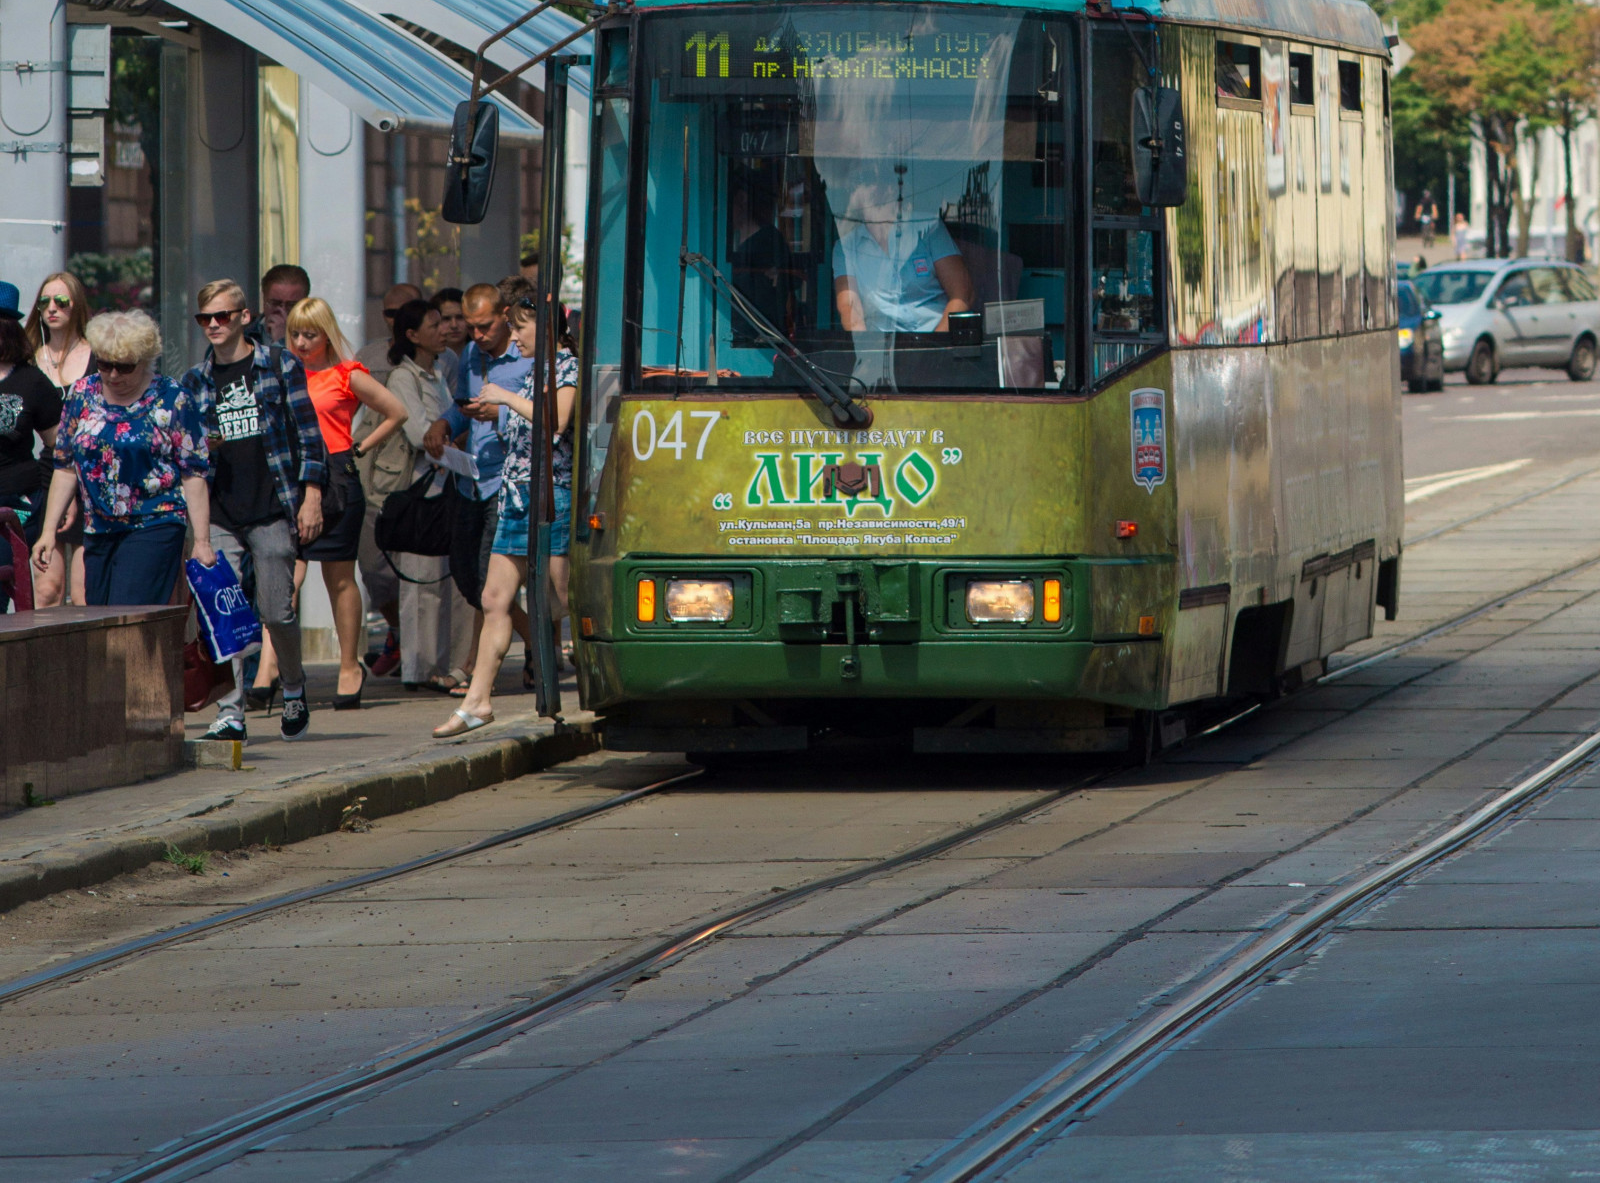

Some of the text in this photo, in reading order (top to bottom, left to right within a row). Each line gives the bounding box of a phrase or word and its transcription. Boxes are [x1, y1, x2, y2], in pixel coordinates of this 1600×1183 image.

[685, 31, 731, 78] 11
[632, 410, 721, 461] 047
[743, 429, 945, 449] ВСЕ ПУТИ ВЕДУТ В
[719, 518, 966, 532] ул.Кульман,5а пр.Независимости,49/1
[728, 534, 958, 547] остановка "Площадь Якуба Коласа"
